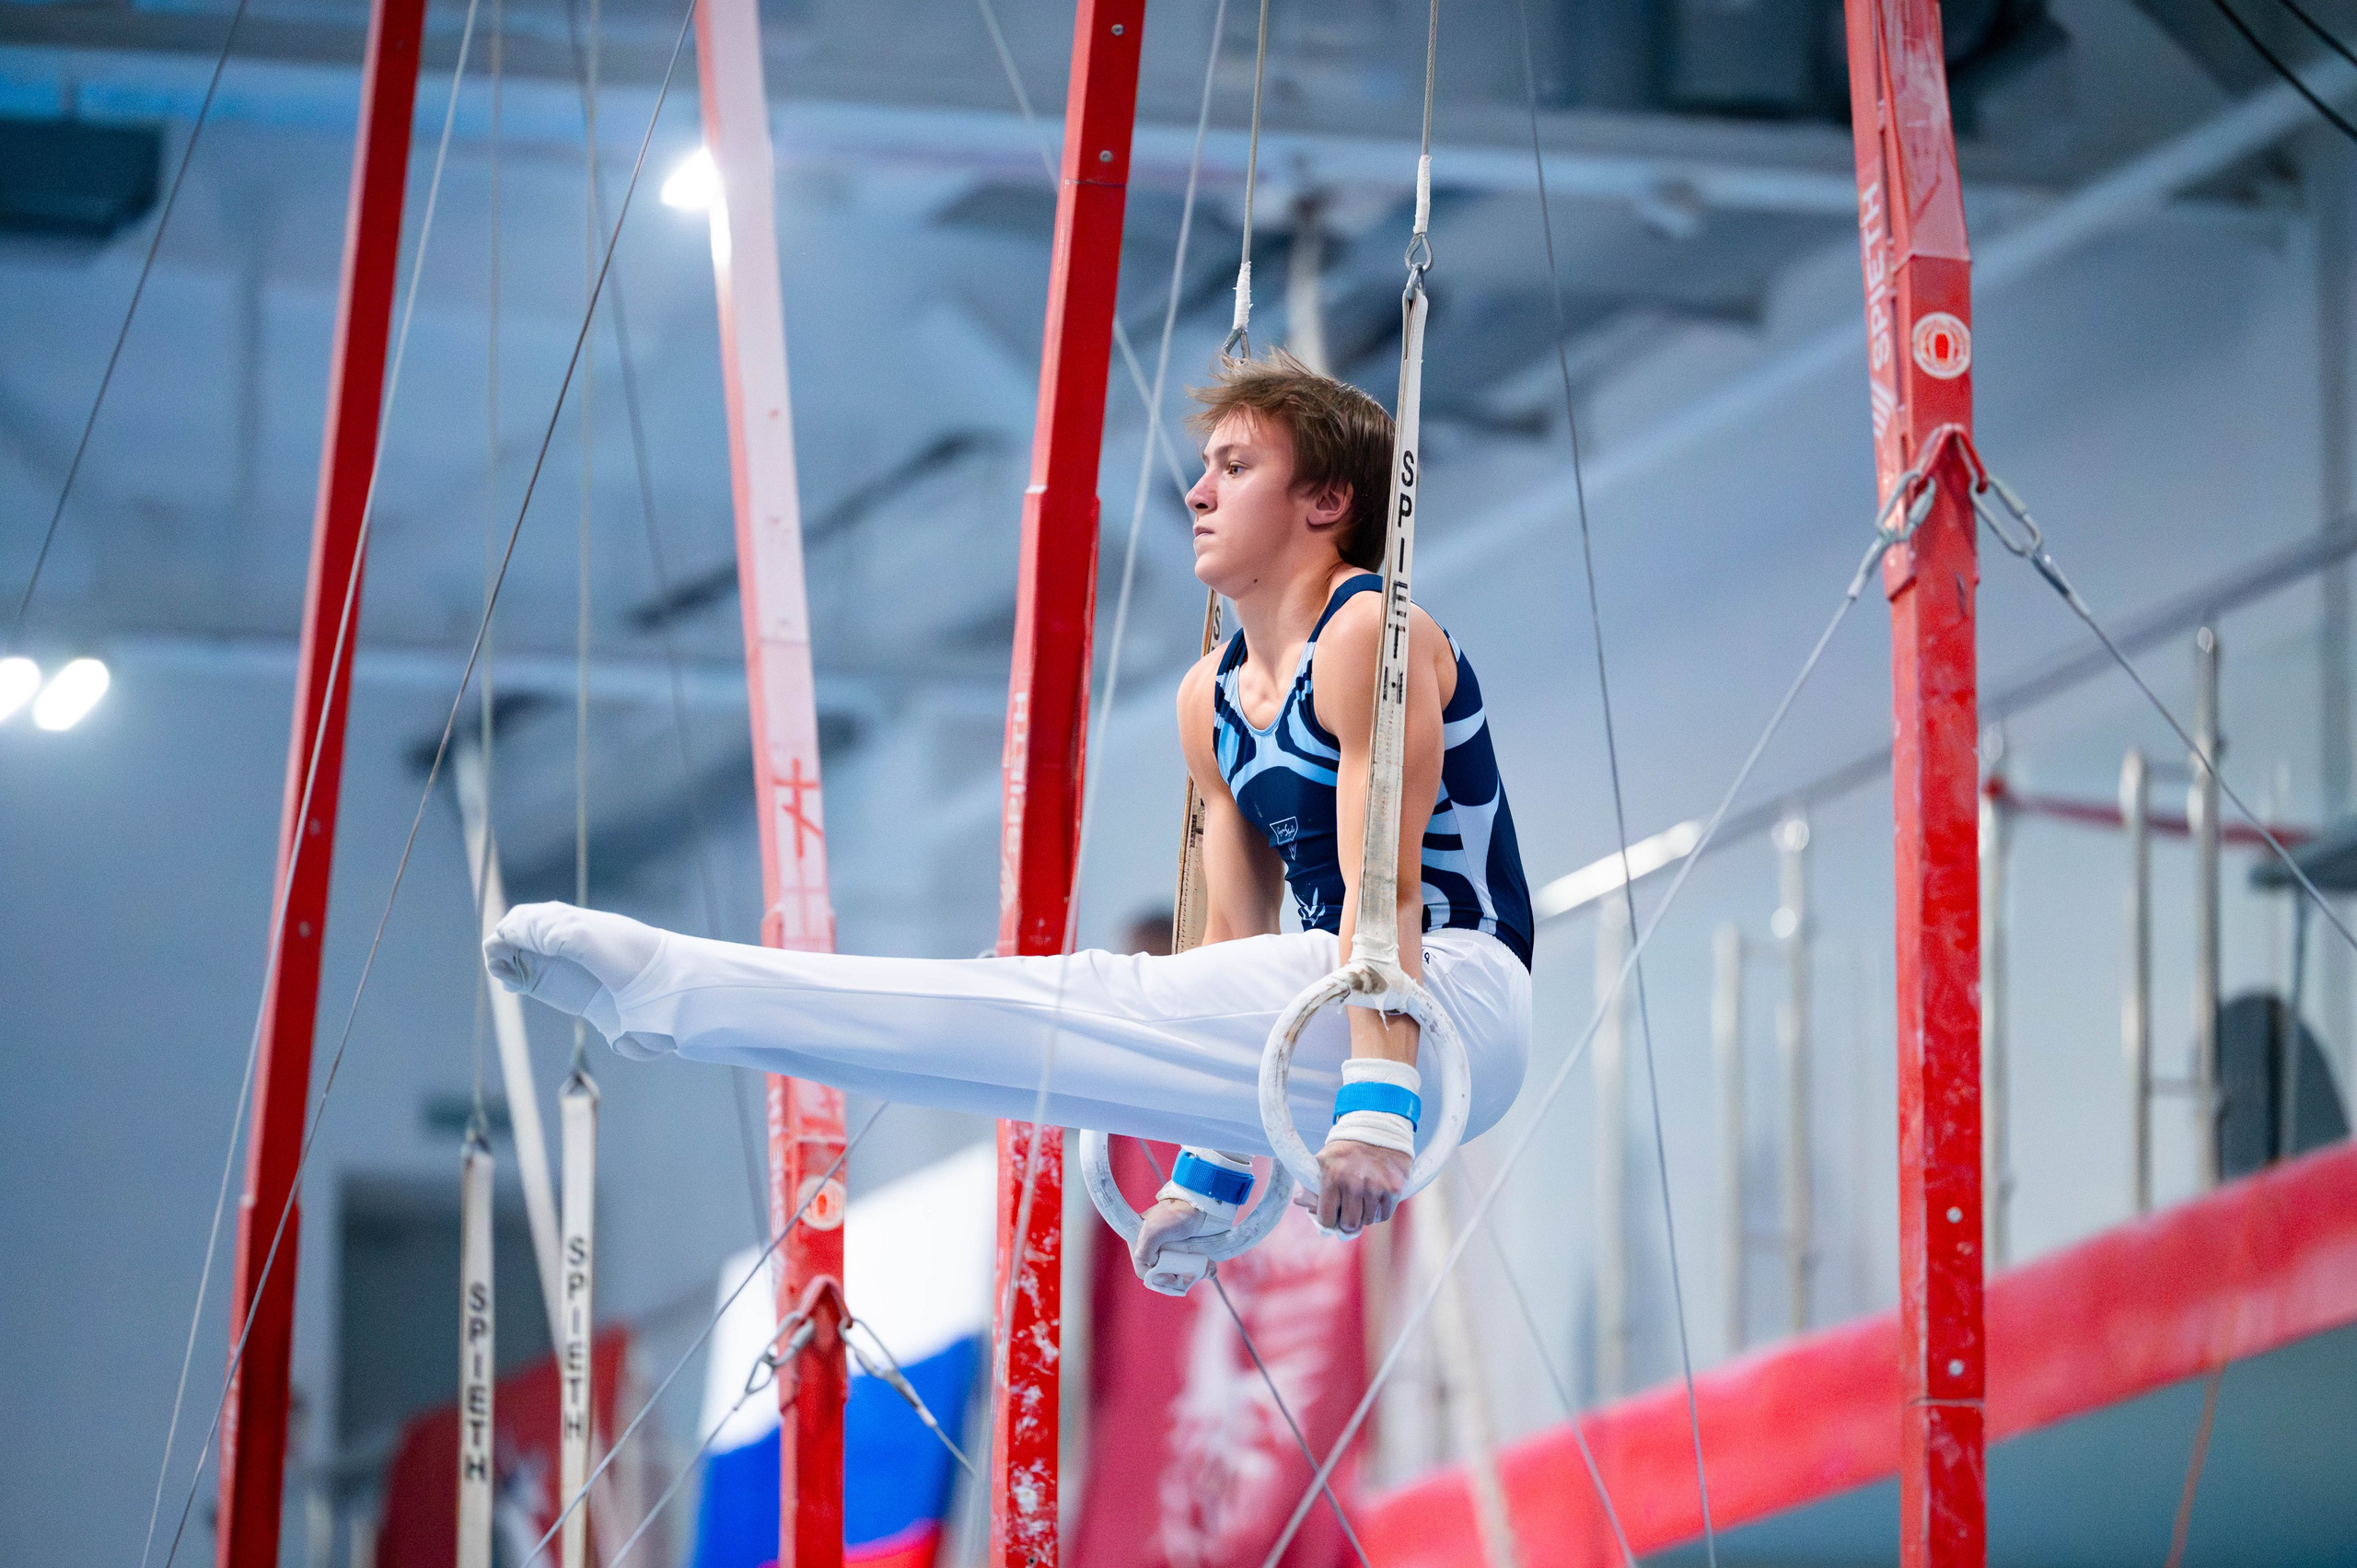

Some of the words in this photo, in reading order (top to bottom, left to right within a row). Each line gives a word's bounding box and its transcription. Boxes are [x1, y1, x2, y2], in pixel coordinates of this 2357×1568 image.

[1863, 182, 1890, 372] SPIETH
[1382, 450, 1414, 705] SPIETH
[466, 1282, 487, 1482] SPIETH
[564, 1237, 586, 1441] SPIETH
